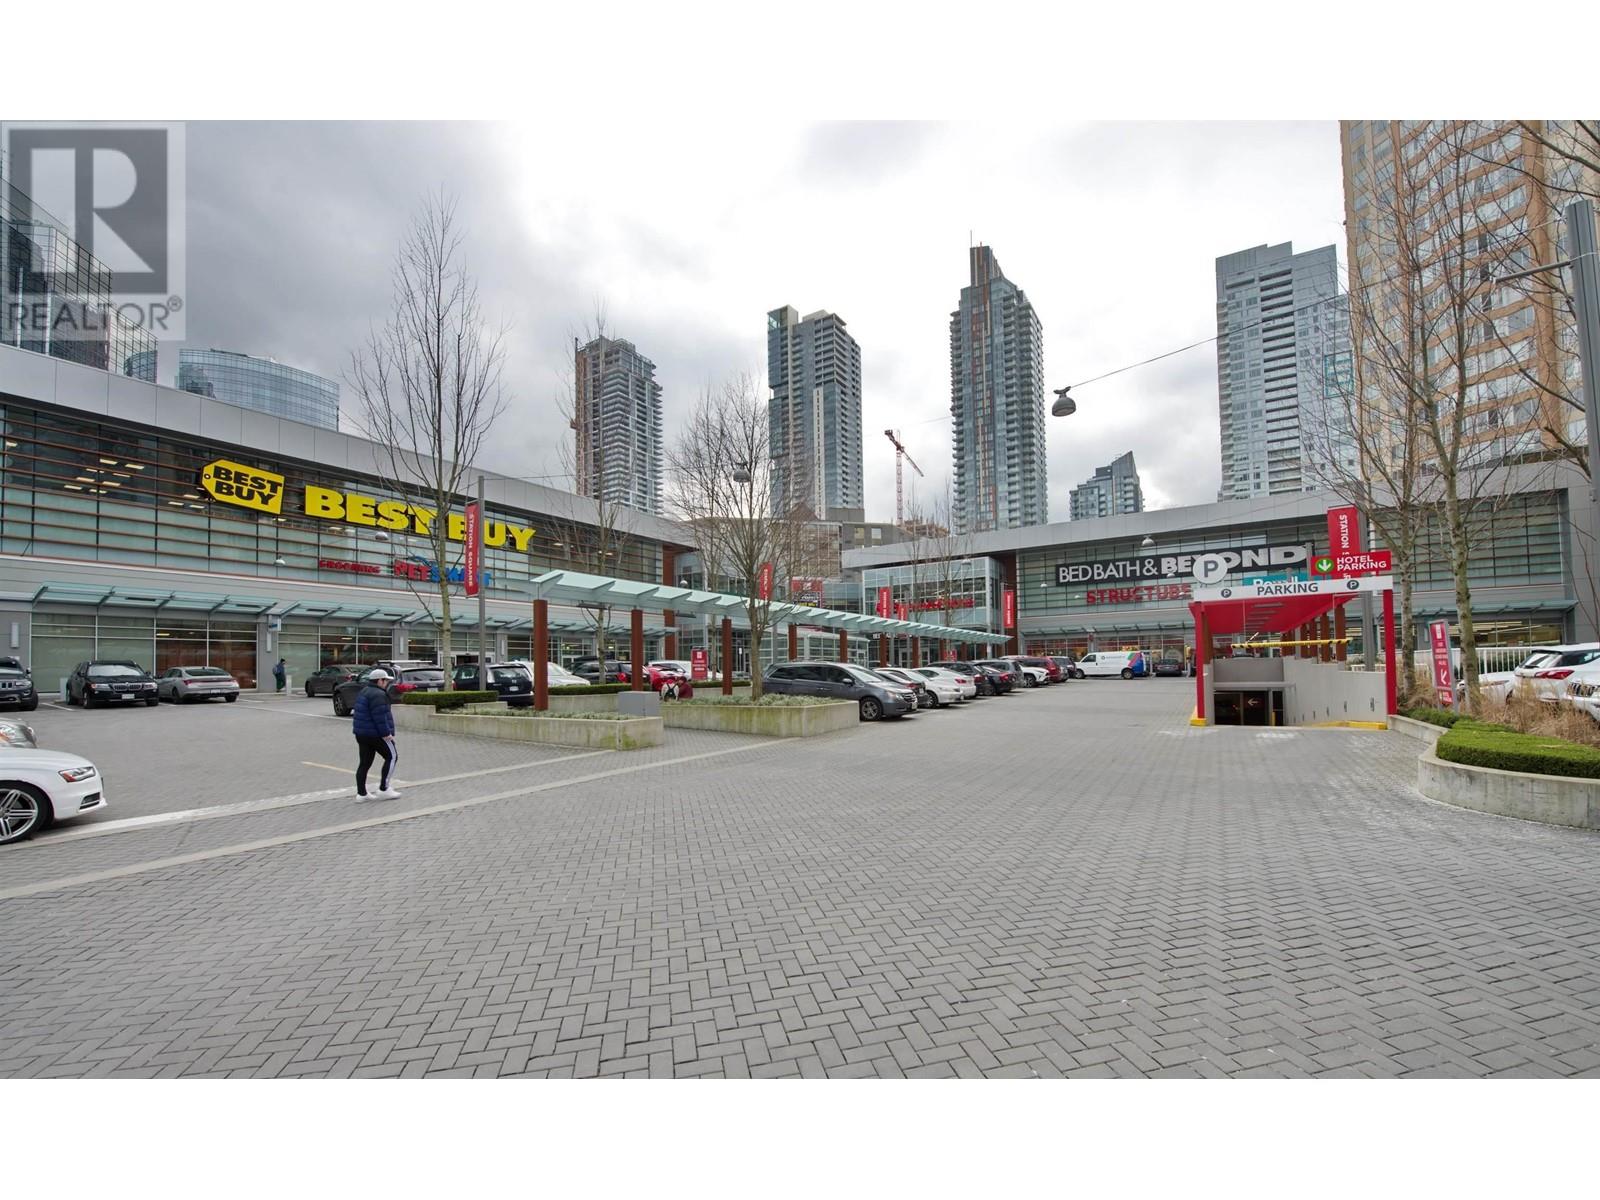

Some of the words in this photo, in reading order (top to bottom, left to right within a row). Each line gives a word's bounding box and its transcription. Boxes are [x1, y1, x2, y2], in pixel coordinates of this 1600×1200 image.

[213, 466, 282, 493] BEST
[214, 481, 276, 505] BUY
[305, 485, 437, 535] BEST
[1339, 514, 1350, 549] STATION
[1059, 565, 1093, 584] BED
[1094, 562, 1140, 580] BATH
[1142, 559, 1158, 576] &
[1161, 545, 1309, 575] BEOND
[1203, 560, 1219, 578] P
[1337, 555, 1373, 565] HOTEL
[1337, 561, 1387, 571] PARKING
[1257, 582, 1319, 596] PARKING
